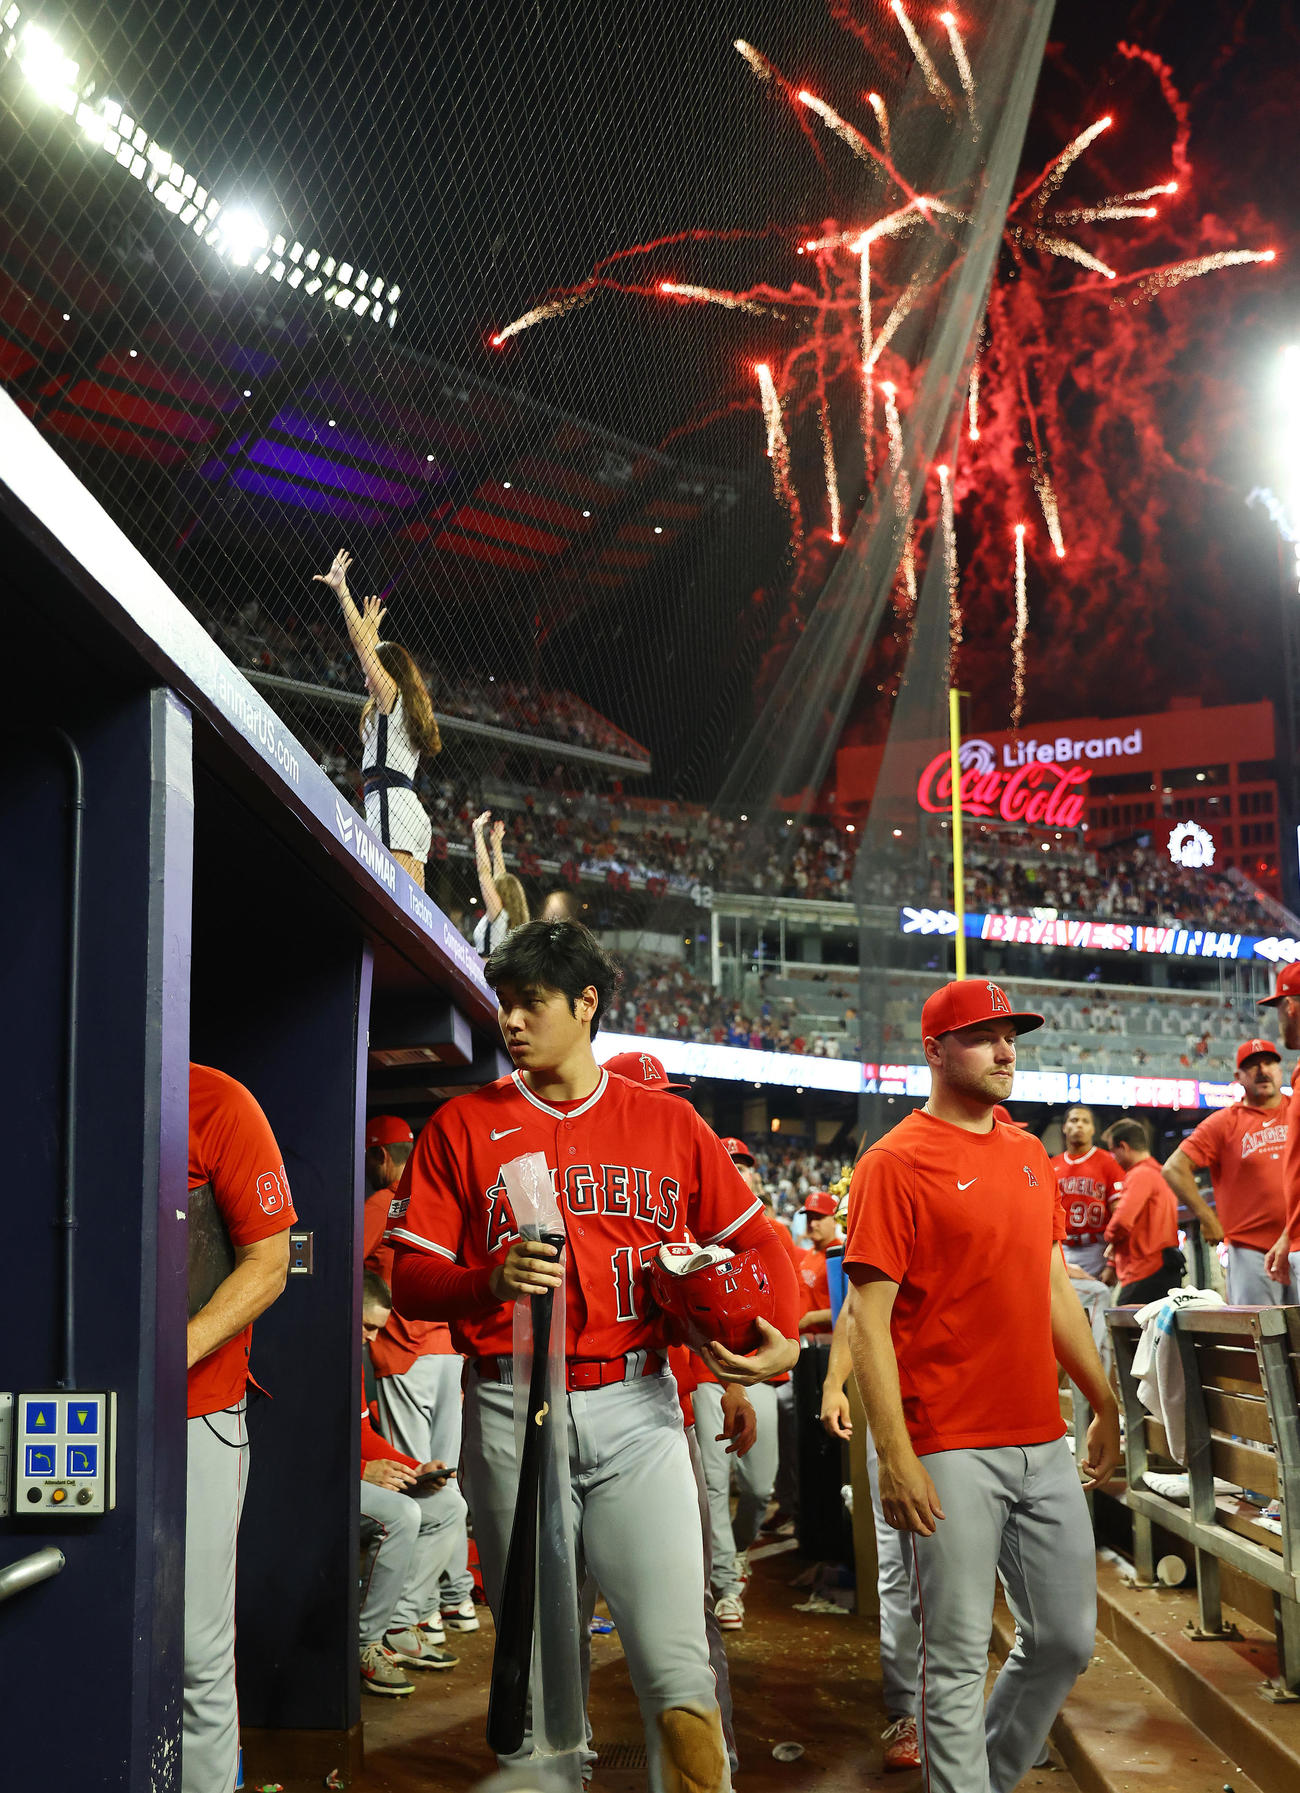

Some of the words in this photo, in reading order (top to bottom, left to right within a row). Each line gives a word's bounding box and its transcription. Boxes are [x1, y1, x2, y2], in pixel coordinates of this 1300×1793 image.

[1003, 728, 1142, 768] LifeBrand
[354, 823, 396, 893] YANMAR
[408, 884, 433, 929] Tractors
[981, 913, 1133, 950] BRAVES
[987, 981, 1009, 1013] A
[639, 1053, 661, 1080] A
[1240, 1125, 1288, 1158] ANGE
[486, 1163, 680, 1255] AGELS
